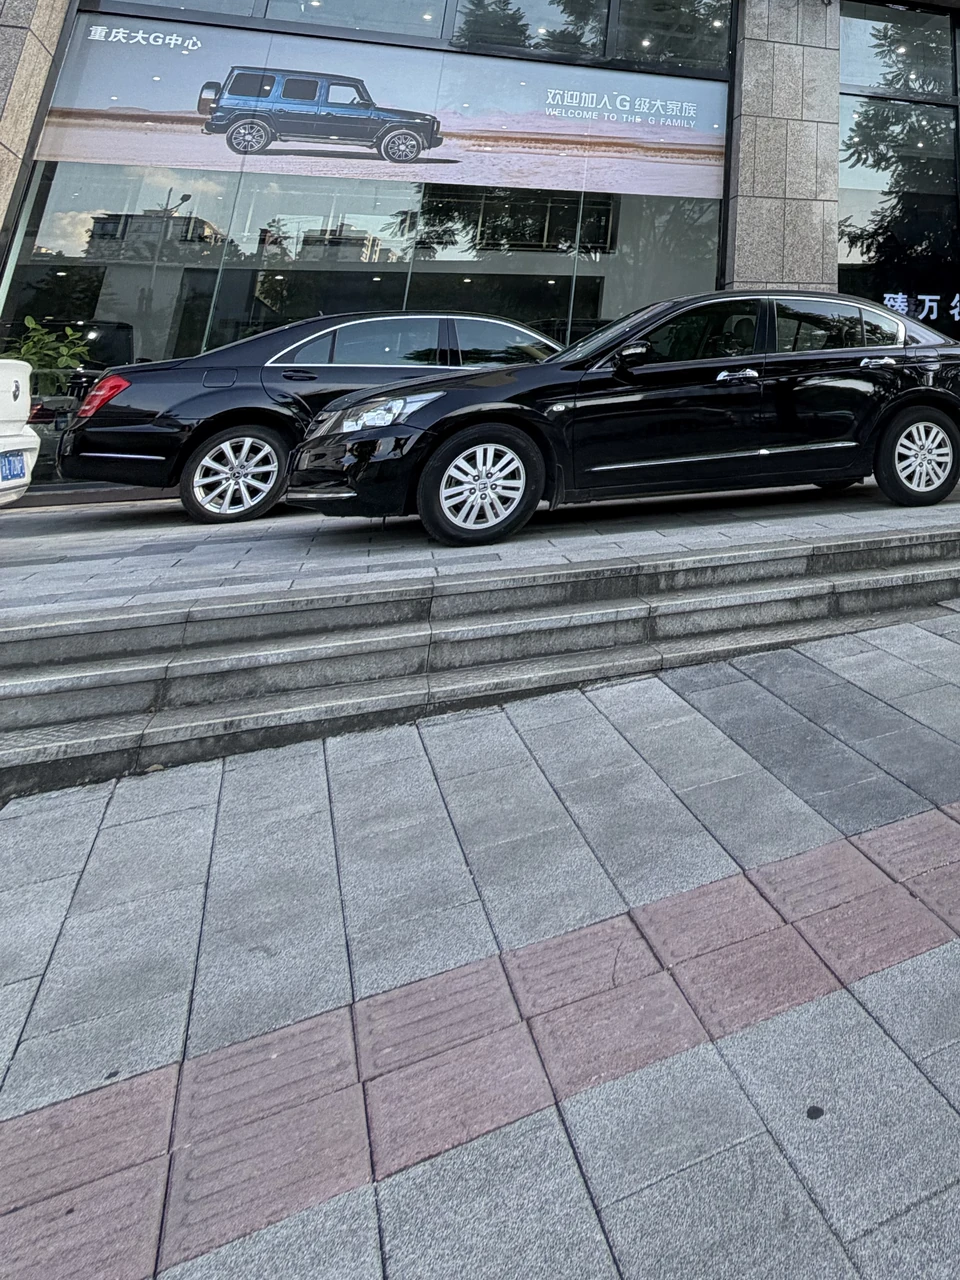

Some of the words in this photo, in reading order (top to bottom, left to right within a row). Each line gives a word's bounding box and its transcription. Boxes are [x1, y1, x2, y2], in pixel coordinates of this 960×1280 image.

[88, 25, 202, 50] 重庆大G中心
[545, 107, 598, 120] WELCOME
[604, 112, 617, 121] TO
[622, 114, 642, 123] THE
[648, 116, 655, 125] G
[660, 117, 696, 129] FAMILY
